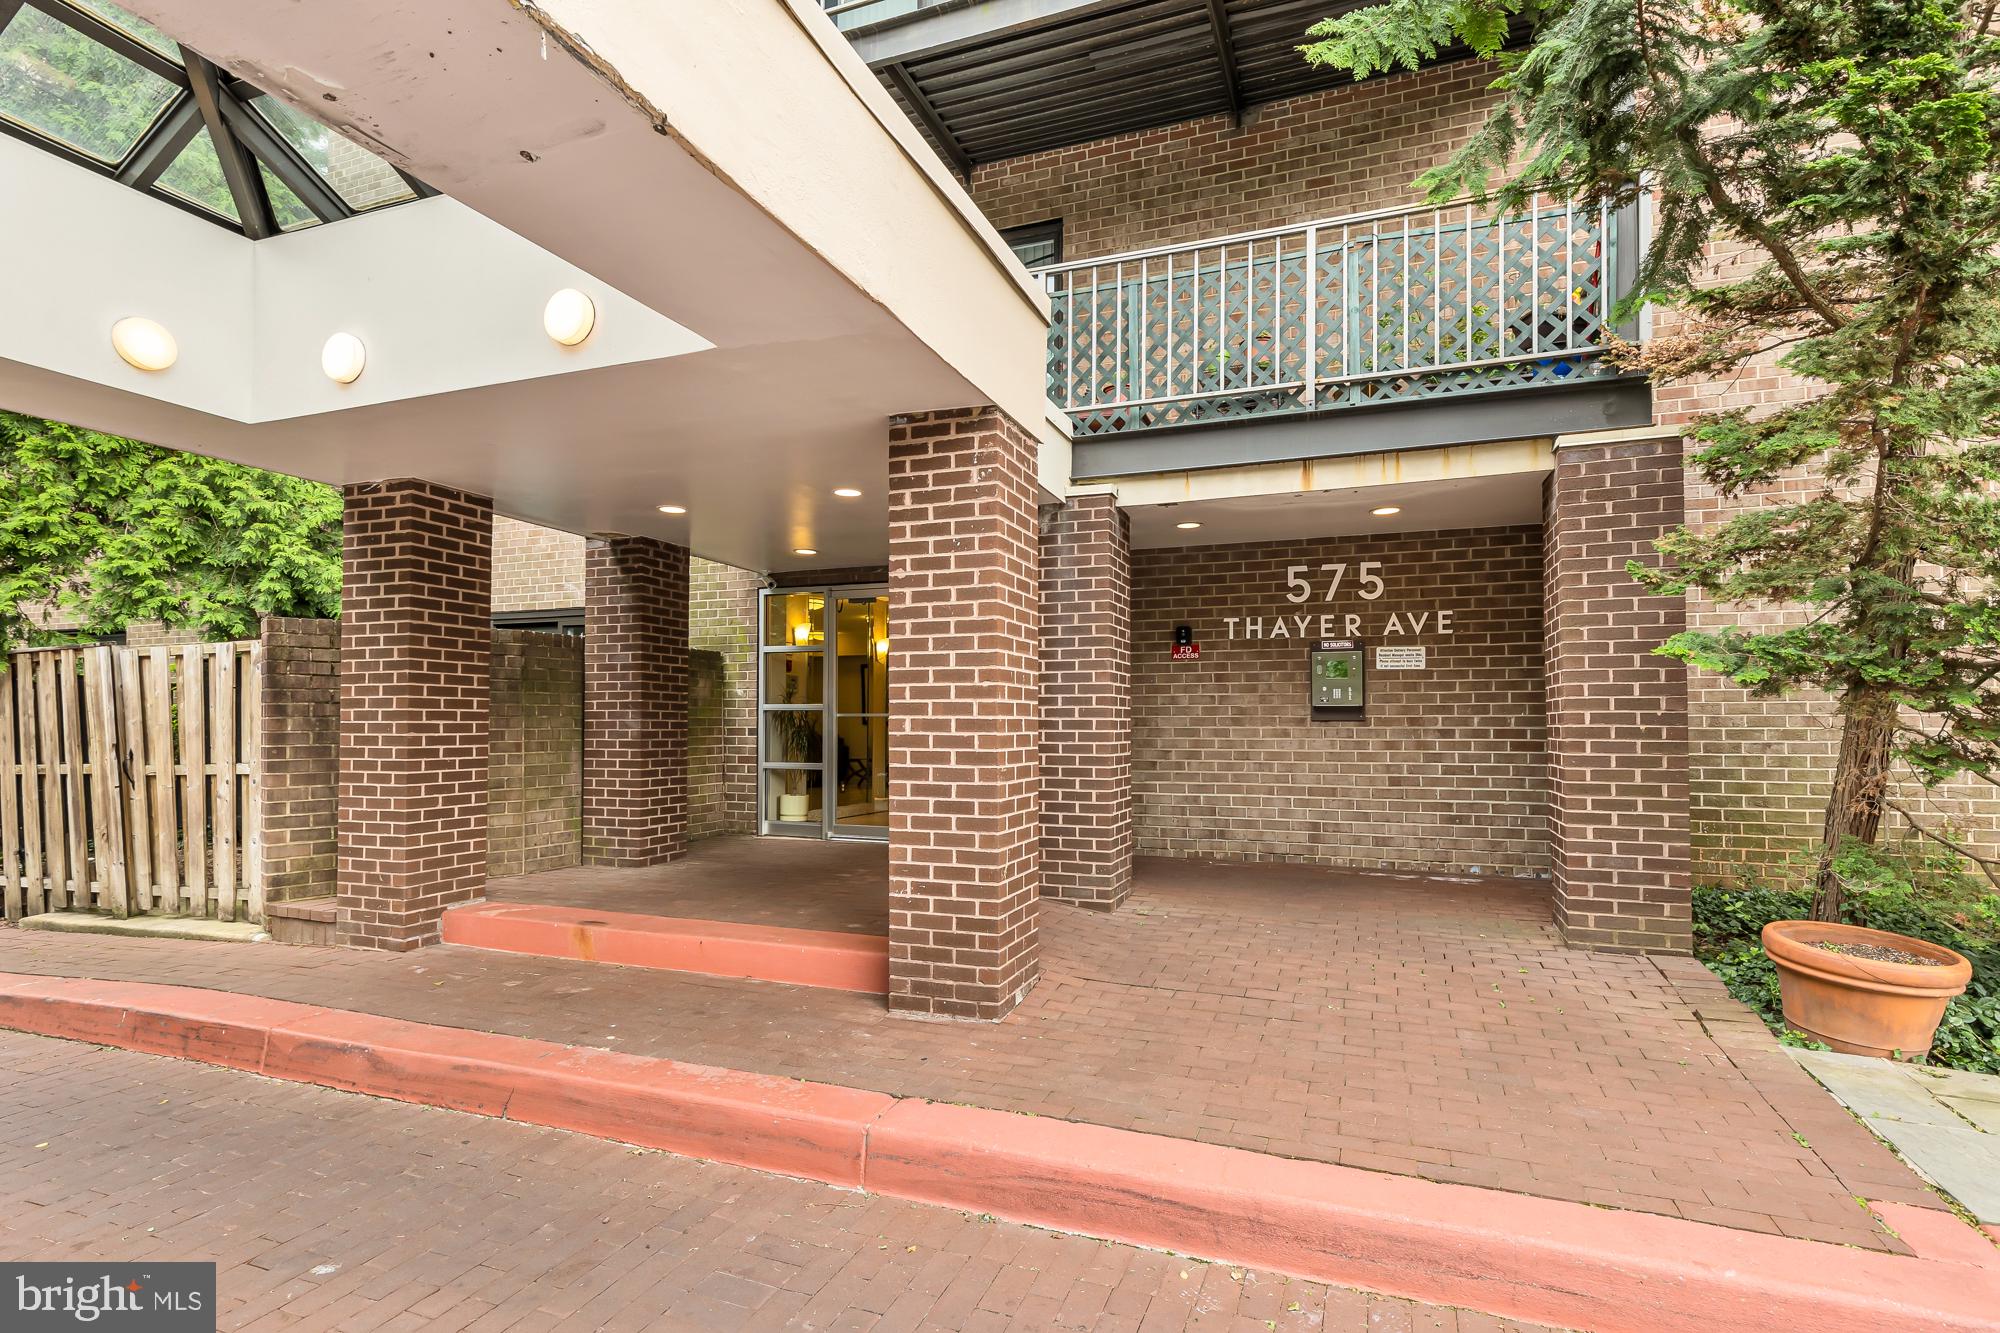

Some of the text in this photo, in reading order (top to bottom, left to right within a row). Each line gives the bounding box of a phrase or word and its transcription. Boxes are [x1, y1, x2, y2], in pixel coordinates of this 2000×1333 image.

[1286, 561, 1385, 603] 575
[1223, 610, 1454, 639] THAYER AVE
[1180, 646, 1193, 654] FD
